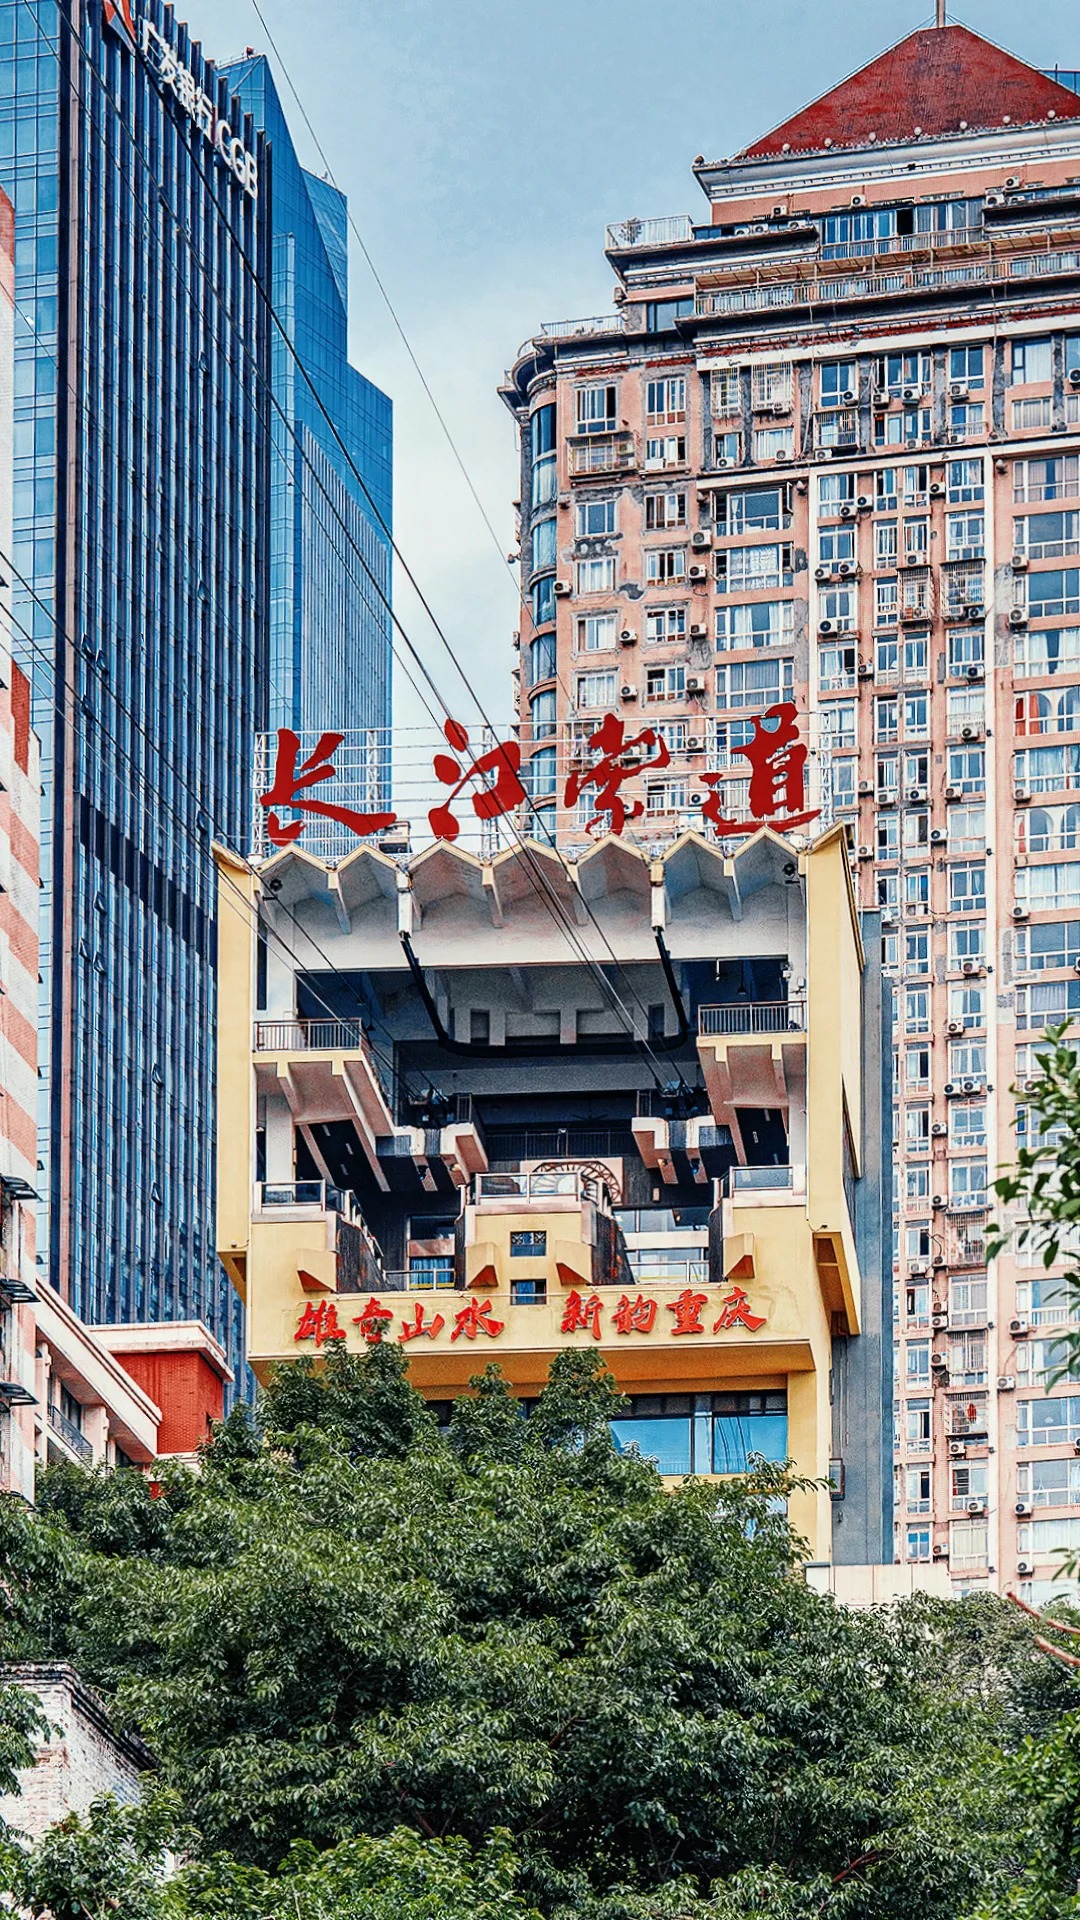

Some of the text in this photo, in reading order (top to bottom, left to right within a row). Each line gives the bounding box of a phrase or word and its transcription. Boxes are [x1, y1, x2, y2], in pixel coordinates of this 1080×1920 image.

[217, 119, 258, 199] CGB
[260, 702, 821, 846] 长江索道
[294, 1287, 767, 1346] 雄奇山水 新韵重庆
